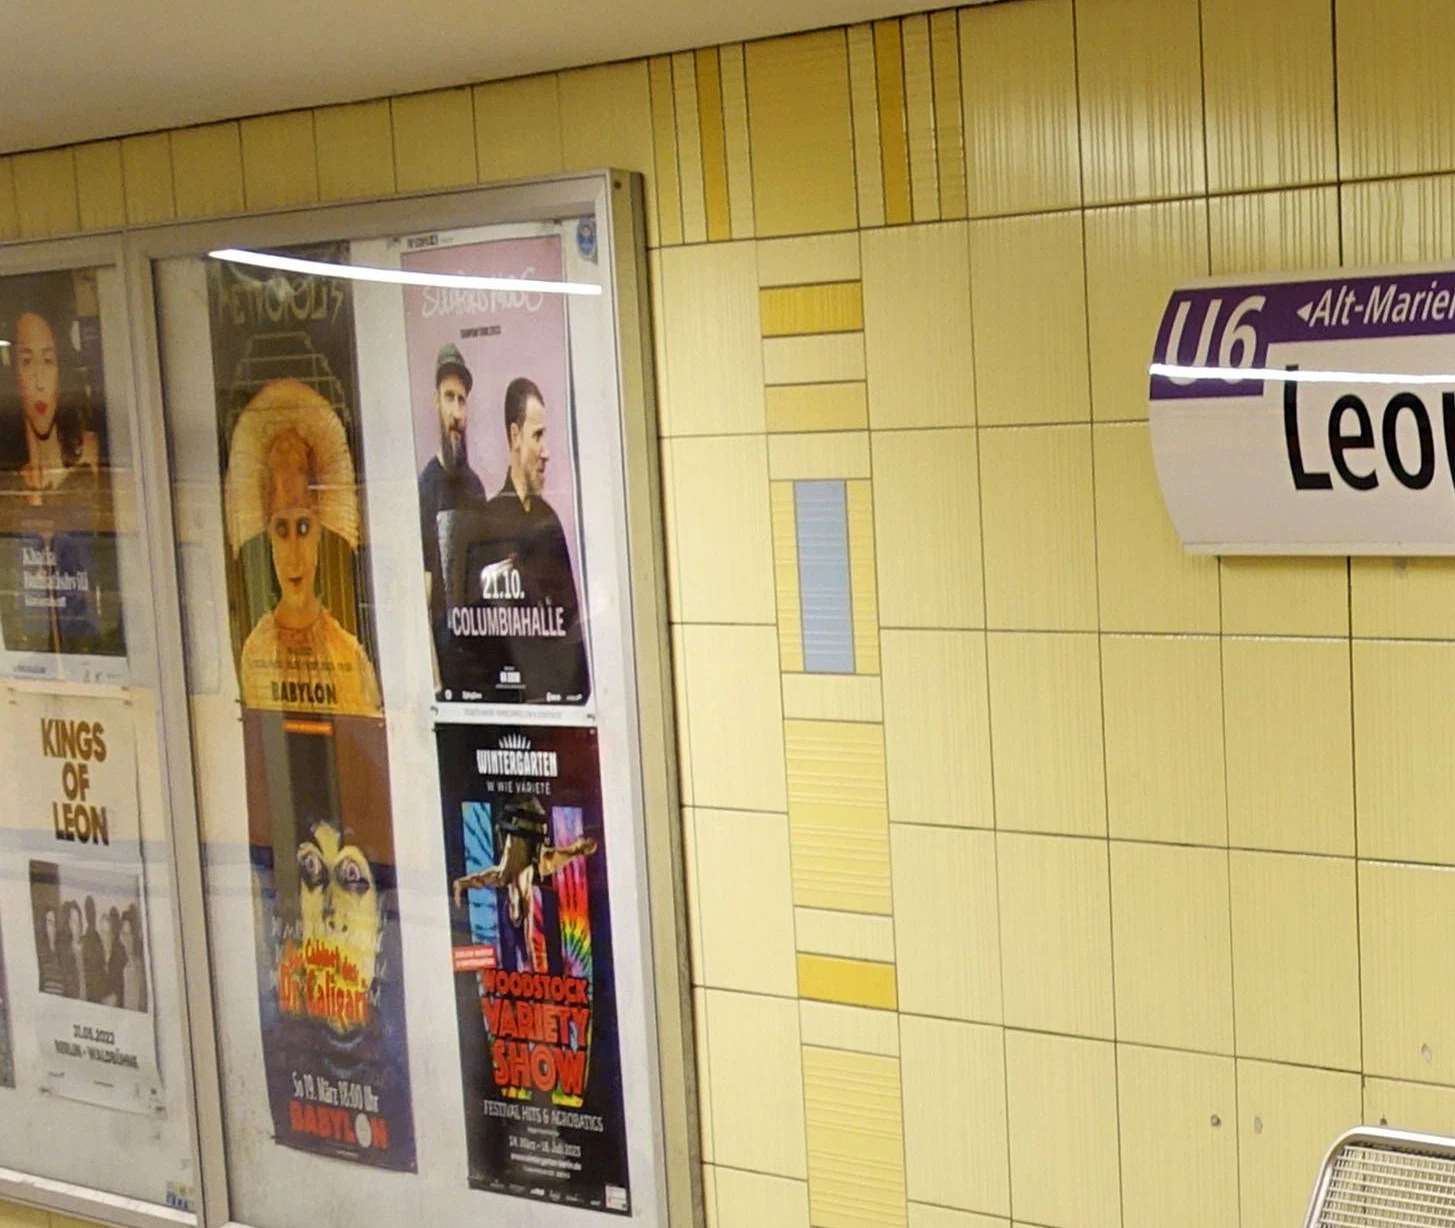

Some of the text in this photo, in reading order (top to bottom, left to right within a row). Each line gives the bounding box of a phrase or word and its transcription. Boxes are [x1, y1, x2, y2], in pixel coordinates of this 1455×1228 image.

[1164, 295, 1267, 387] U6
[482, 569, 526, 600] 21.10.
[452, 606, 567, 637] COLUMBIAHALLE
[271, 681, 338, 705] BABYLON
[40, 717, 107, 763] KINGS
[62, 761, 90, 802] OF
[476, 749, 558, 777] WINTERGARTEN
[52, 801, 110, 847] LEON
[481, 969, 588, 1003] WOODSTOCK
[482, 997, 589, 1045] VARIETY
[490, 1039, 587, 1095] SHOW
[290, 1100, 390, 1150] BABYLON
[483, 1099, 521, 1121] FESTIVAL
[550, 1110, 604, 1133] ACROBATICS
